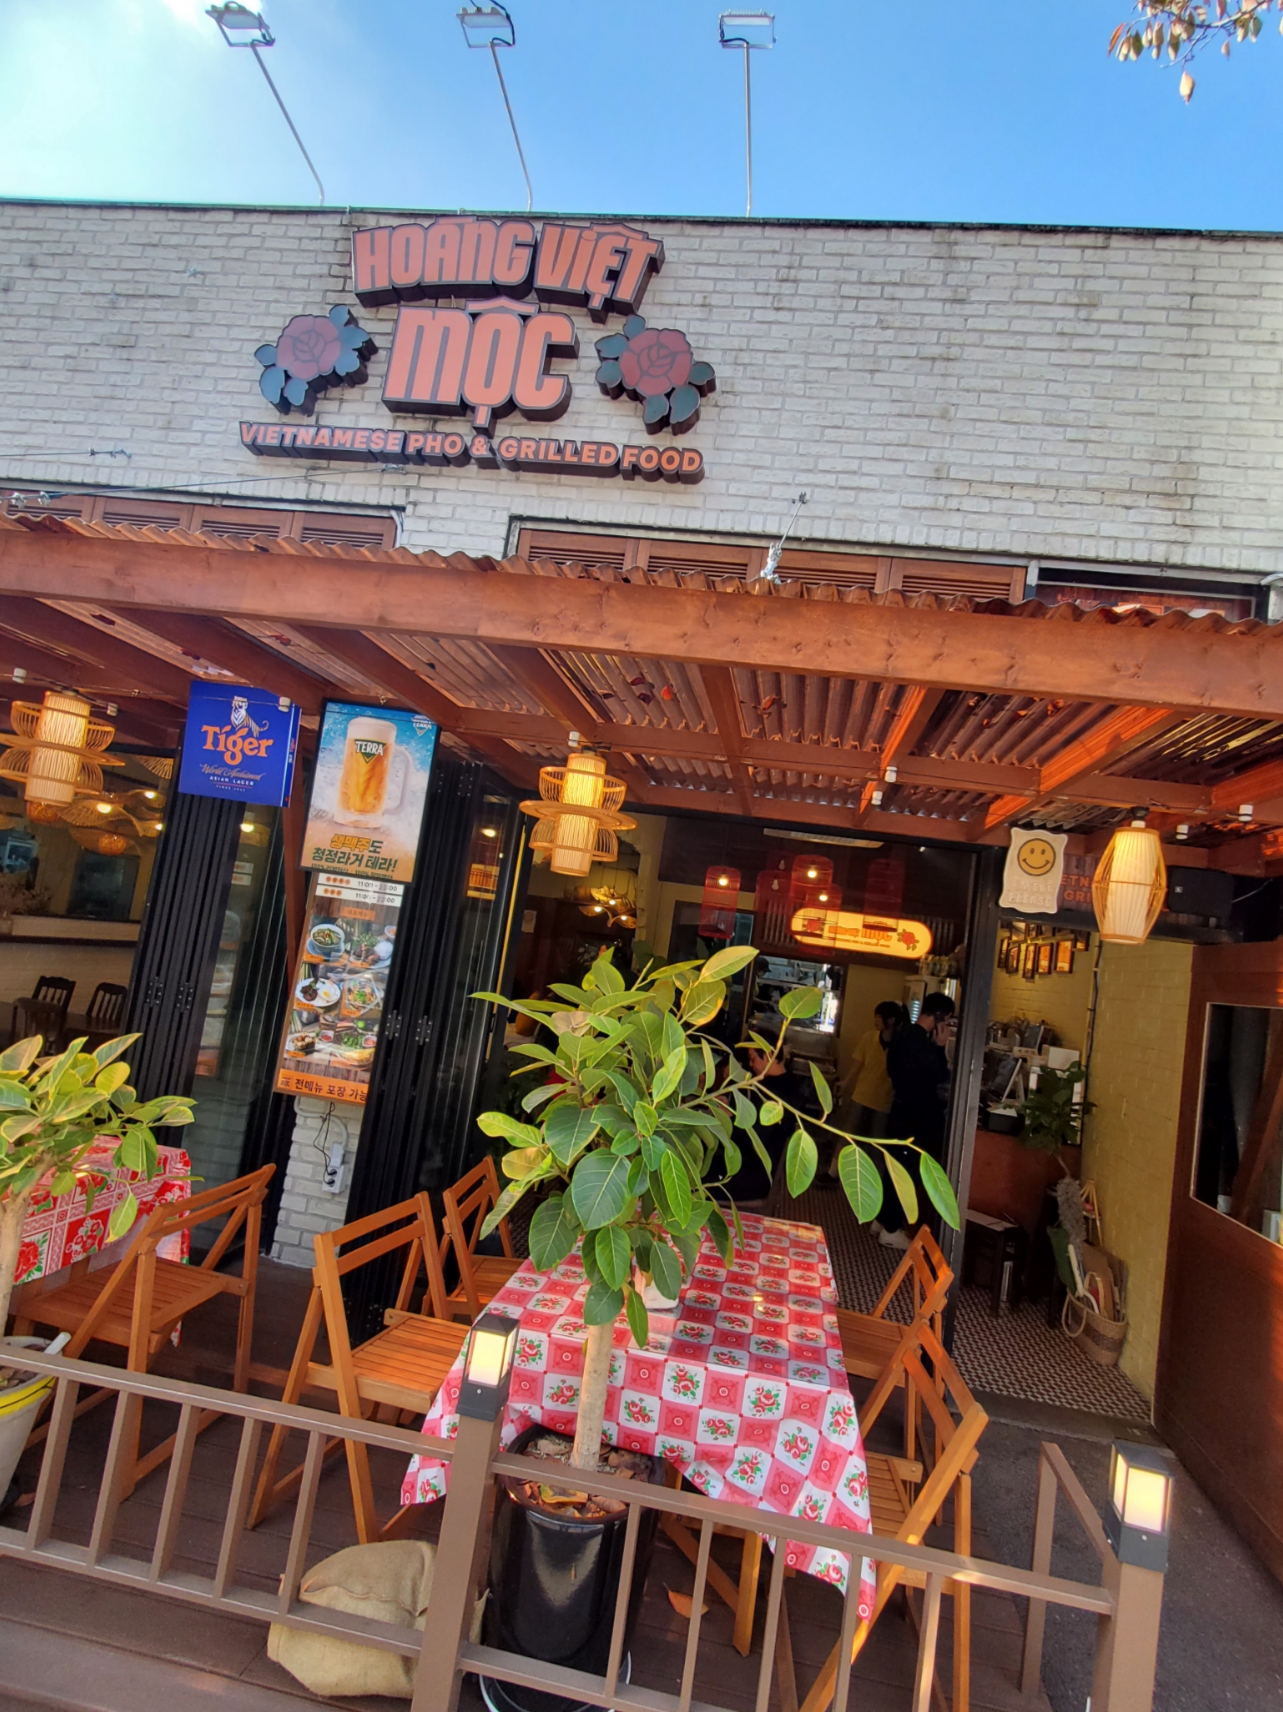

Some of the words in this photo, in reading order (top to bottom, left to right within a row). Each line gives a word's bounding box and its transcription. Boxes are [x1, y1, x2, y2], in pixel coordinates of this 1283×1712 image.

[240, 422, 403, 452] VIETNAMESE
[408, 433, 465, 456] PHO
[471, 436, 489, 456] &
[499, 437, 618, 466] GRILLED
[622, 447, 702, 472] FOOD
[201, 725, 274, 765] Tiger
[355, 740, 384, 756] TERRA
[209, 775, 230, 783] ASIAN
[232, 778, 254, 787] LAGER
[329, 833, 384, 854] 생맥주도
[312, 847, 364, 868] 청정라거
[364, 855, 398, 873] 테라!
[1012, 877, 1054, 892] SMILE
[1008, 892, 1051, 907] PLEASE
[294, 1078, 323, 1093] 전메뉴
[326, 1084, 346, 1097] 포장
